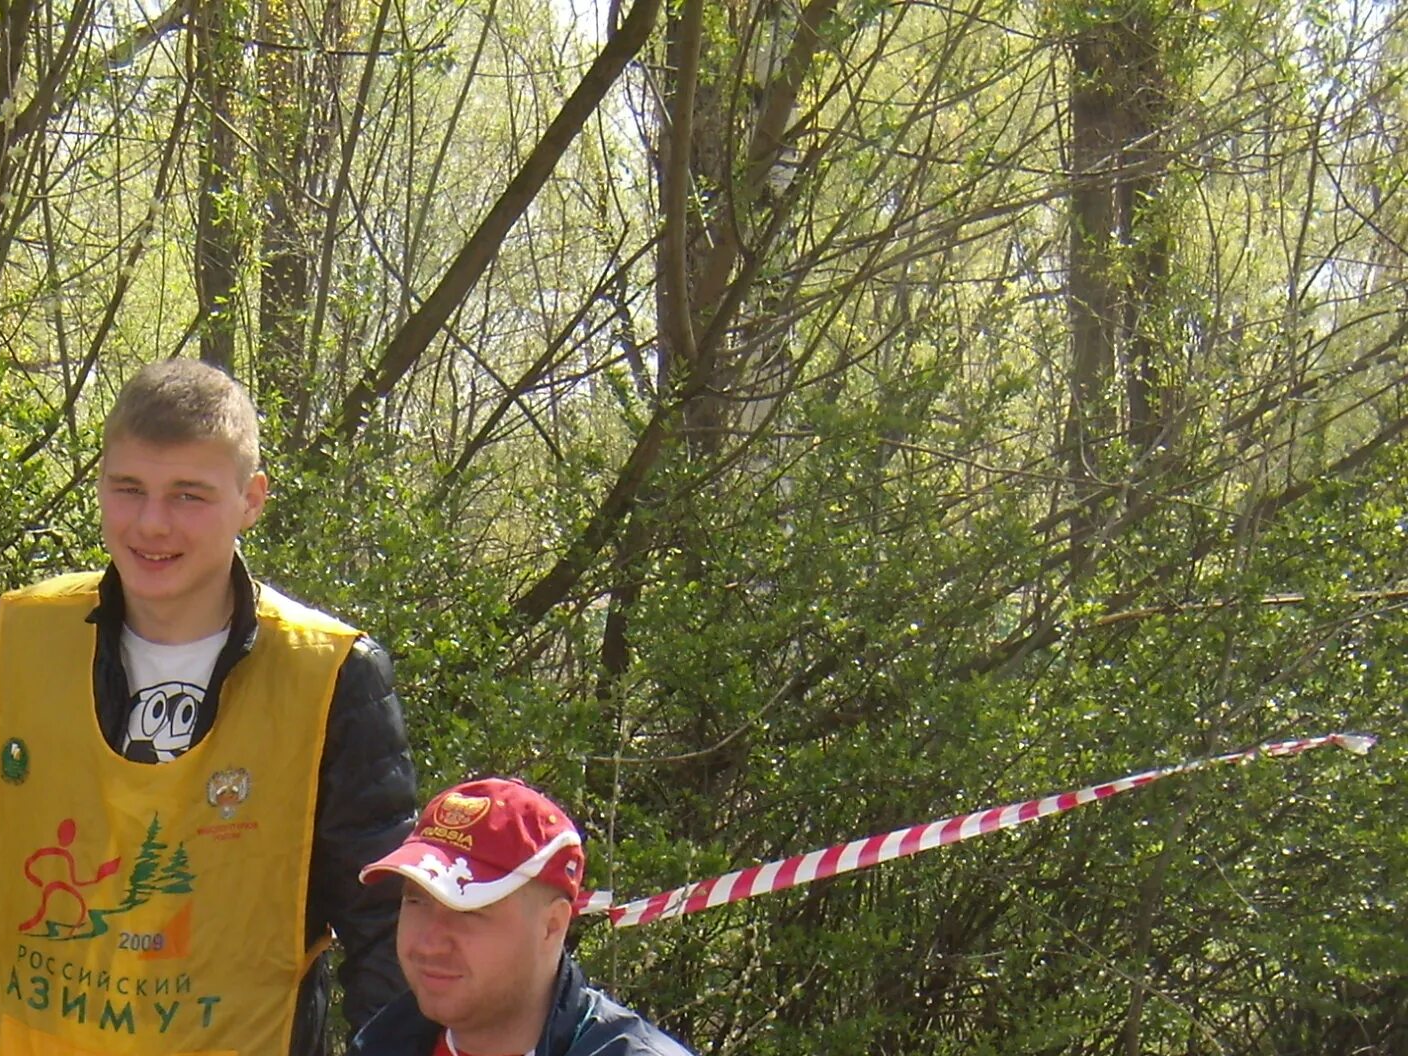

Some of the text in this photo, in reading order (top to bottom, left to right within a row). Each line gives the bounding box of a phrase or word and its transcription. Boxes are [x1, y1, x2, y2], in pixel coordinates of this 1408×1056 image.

[421, 826, 473, 846] RUSSIA
[118, 932, 165, 951] 2009
[17, 944, 190, 997] РОССИЙСКИЙ
[7, 965, 221, 1034] АЗИМУТ
